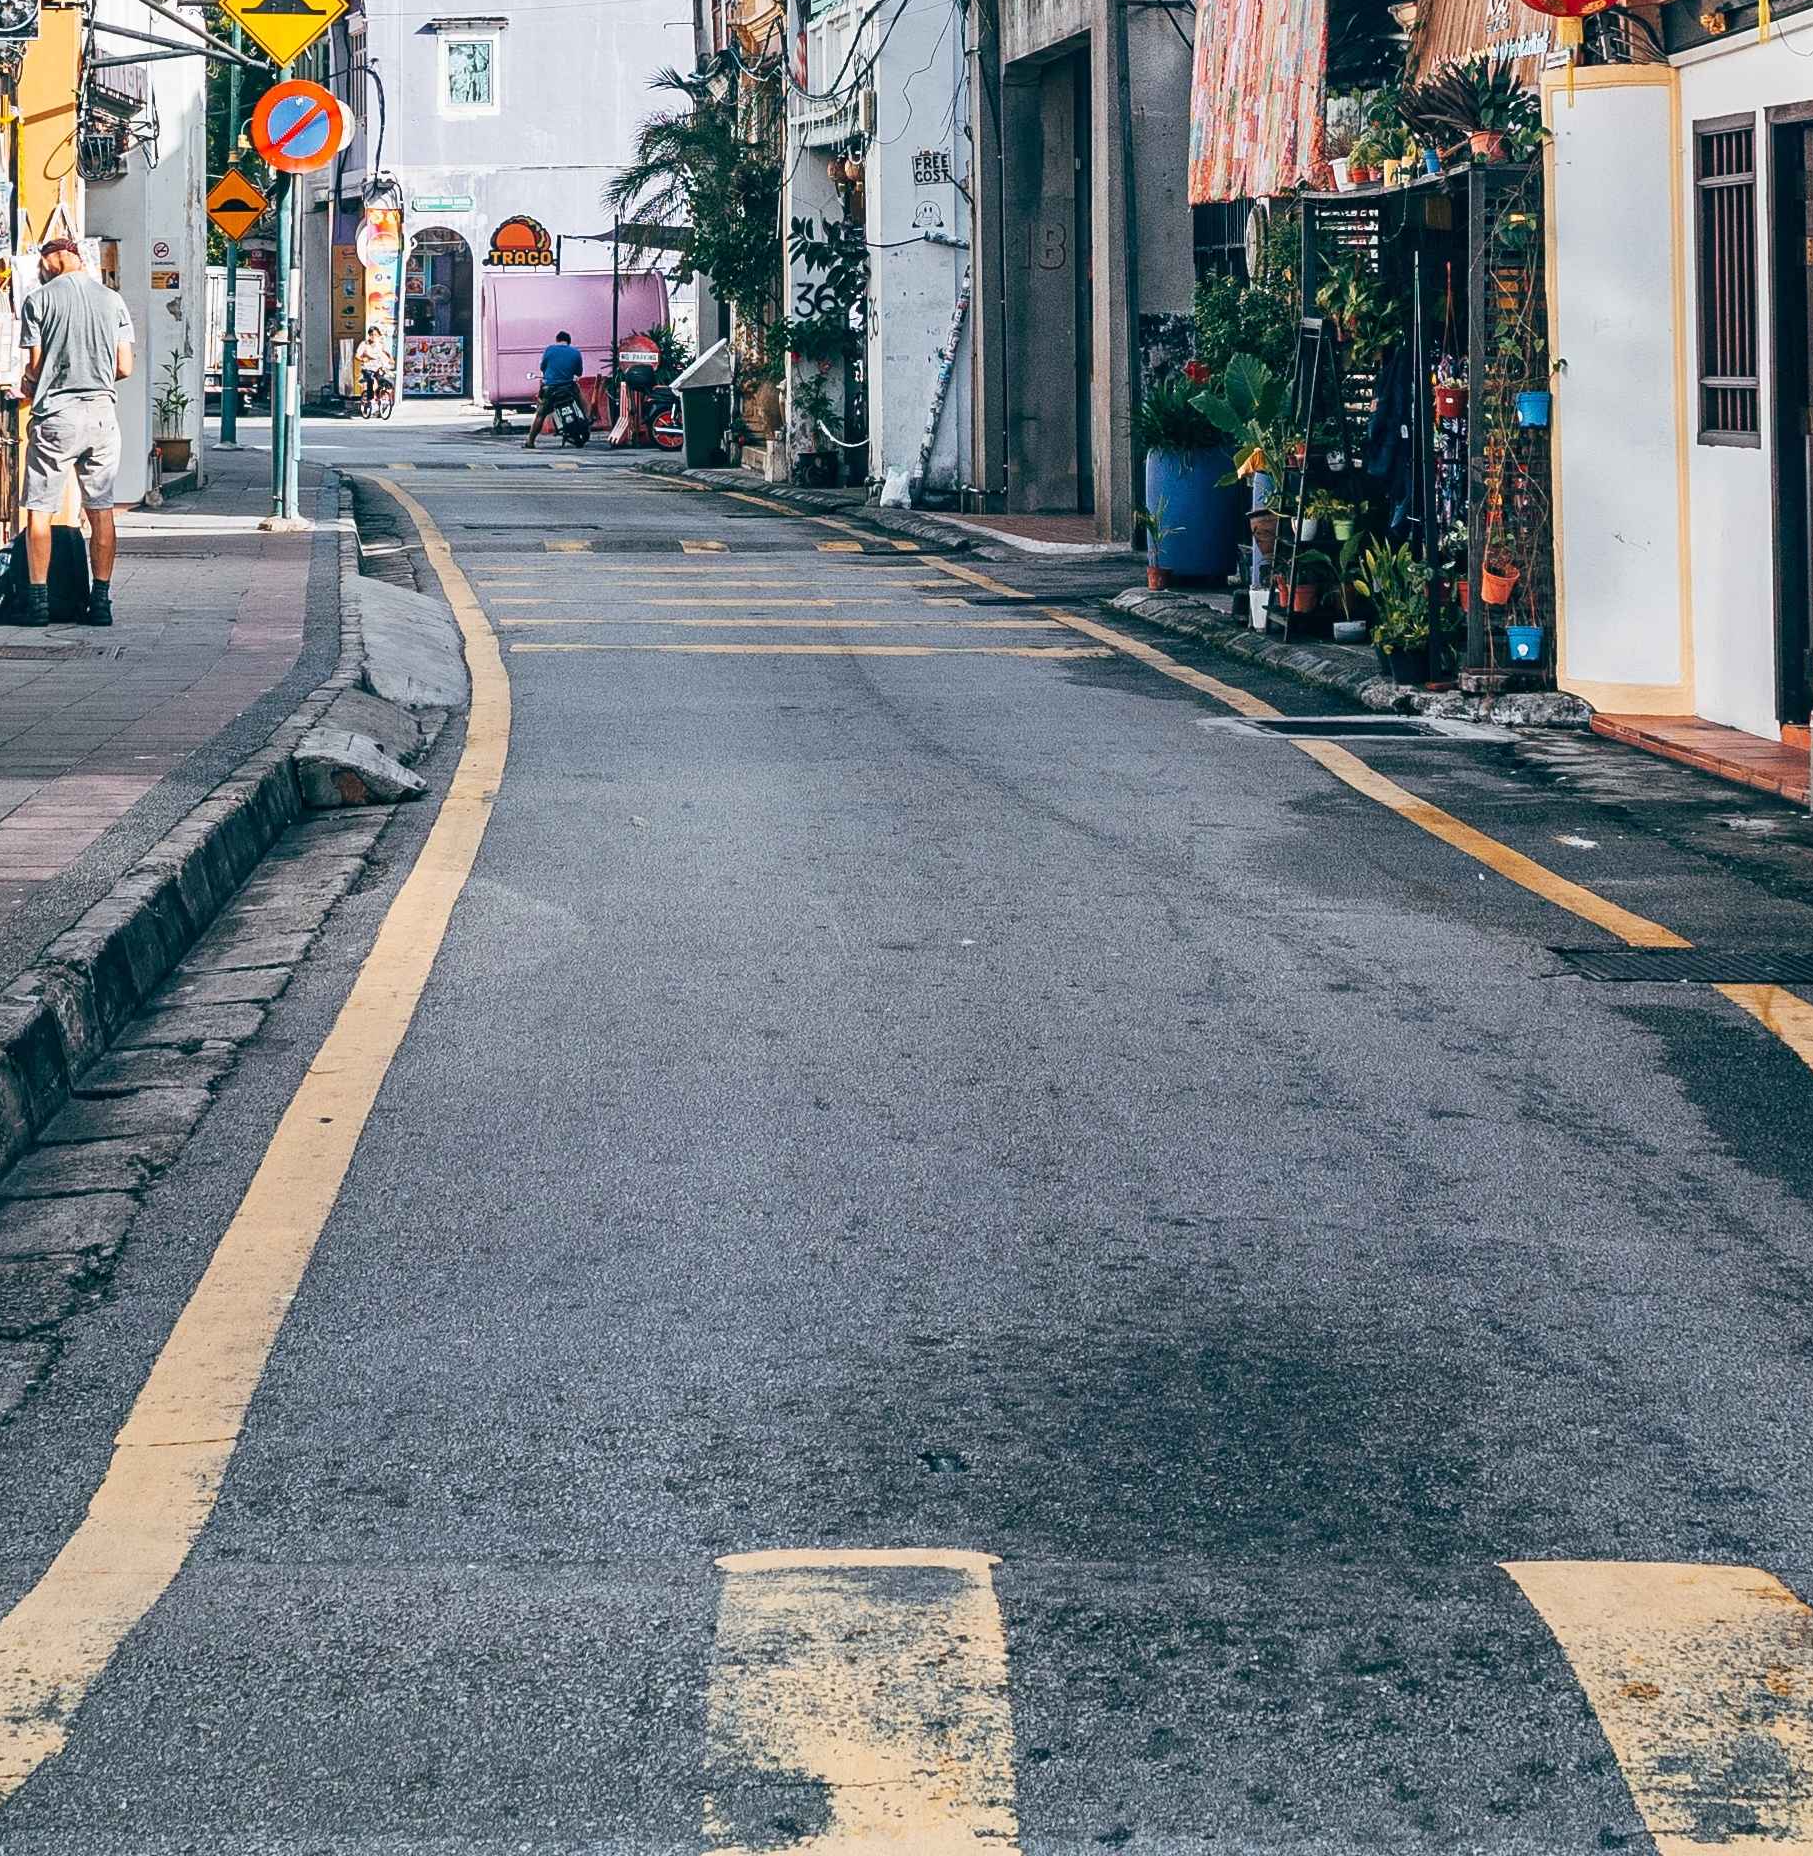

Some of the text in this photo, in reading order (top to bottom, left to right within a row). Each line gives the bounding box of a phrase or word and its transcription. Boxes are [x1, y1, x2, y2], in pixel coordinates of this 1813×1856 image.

[915, 155, 949, 170] FREE
[915, 169, 950, 183] COST
[490, 251, 553, 266] TRACO
[795, 282, 837, 318] 36
